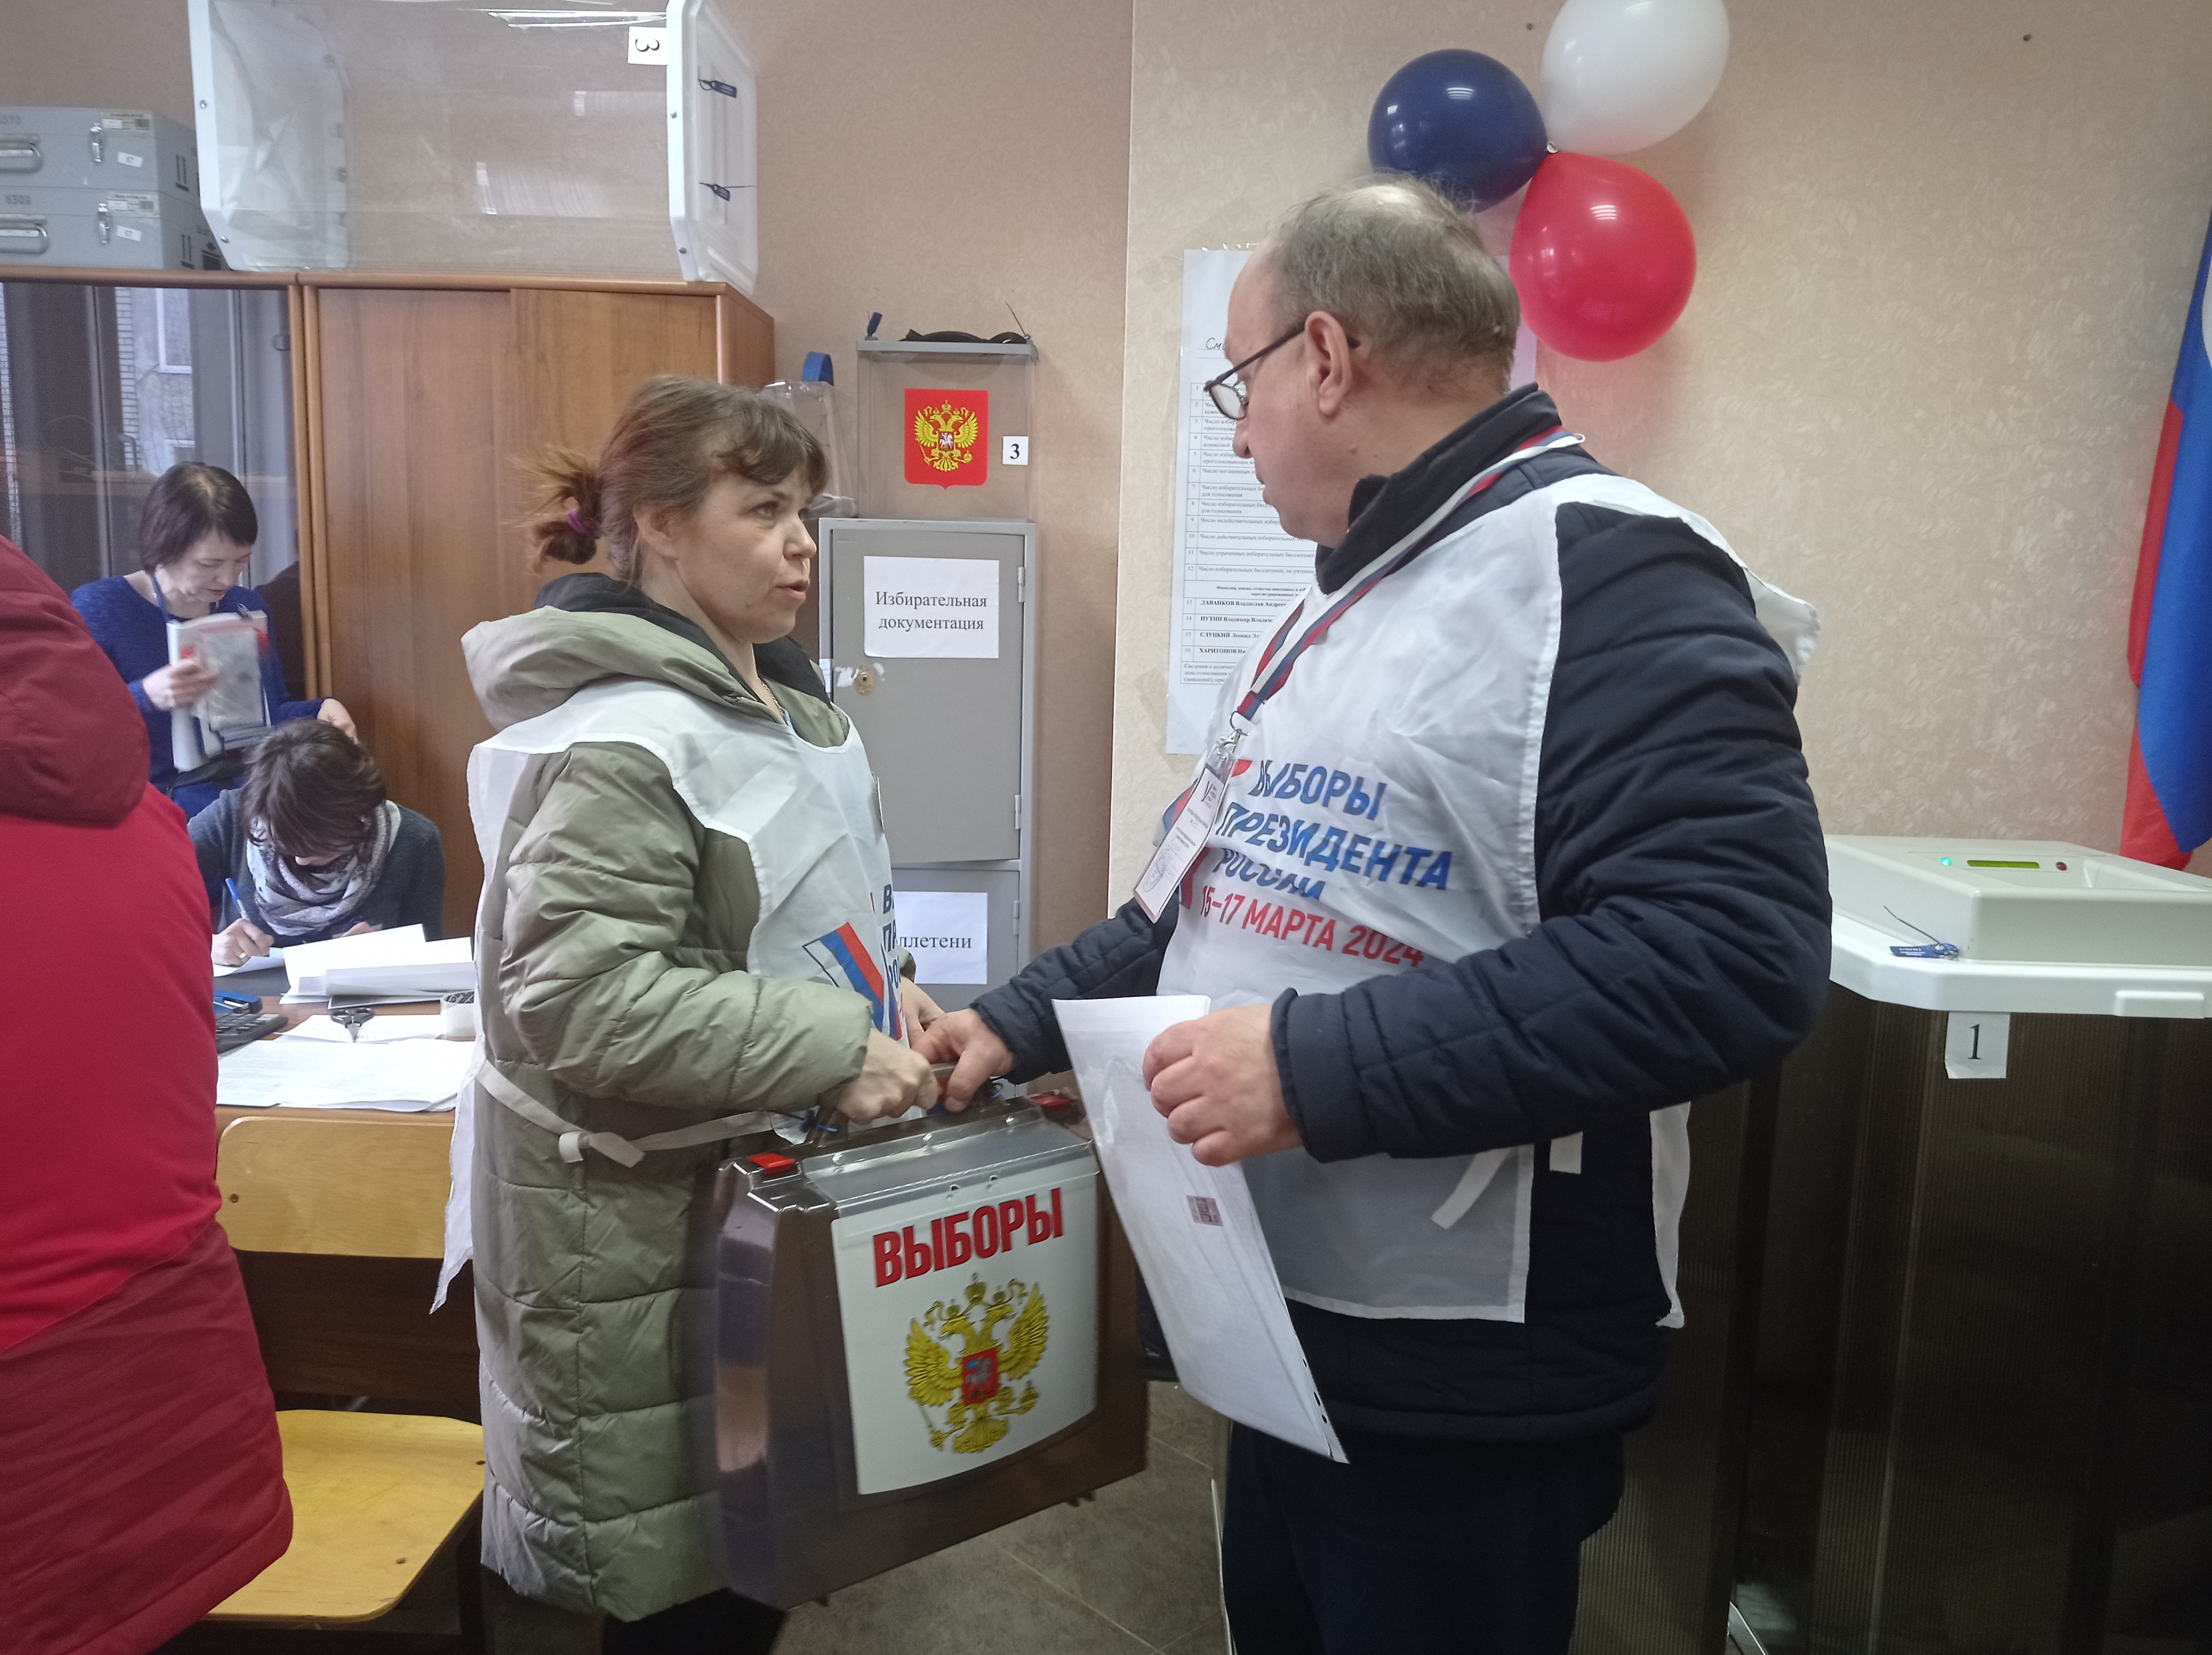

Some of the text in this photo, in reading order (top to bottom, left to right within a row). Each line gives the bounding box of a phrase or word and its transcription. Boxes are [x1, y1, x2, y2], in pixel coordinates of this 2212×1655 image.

[635, 39, 660, 52] 3
[1010, 443, 1020, 460] 3
[875, 591, 988, 609] Избирательная
[879, 618, 984, 632] документация
[1248, 759, 1387, 821] ВЫБОРЫ
[1215, 802, 1452, 890] ПРЕЗИДЕНТА
[1201, 886, 1424, 968] 15-17 МАРТА 2024
[899, 936, 972, 949] ллетени
[1968, 1024, 1981, 1059] 1
[873, 1187, 1063, 1288] ВЫБОРЫ
